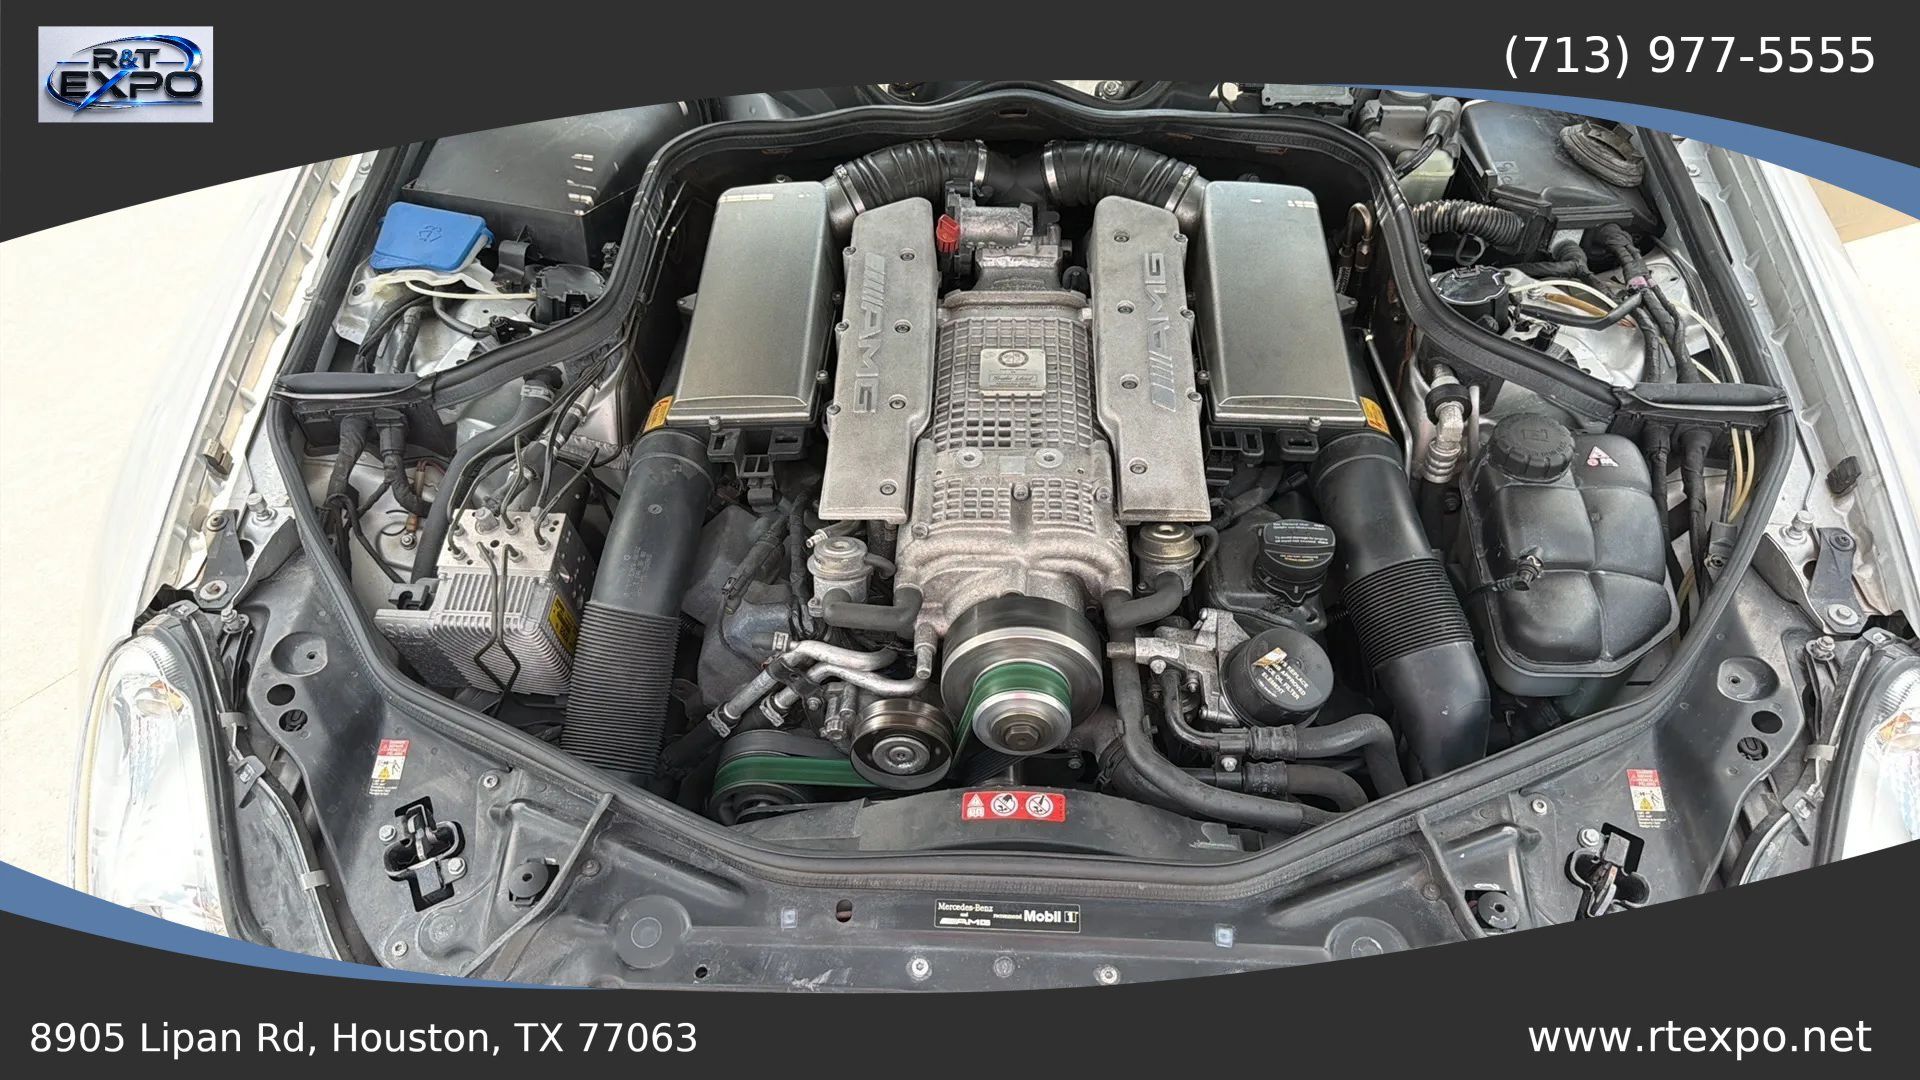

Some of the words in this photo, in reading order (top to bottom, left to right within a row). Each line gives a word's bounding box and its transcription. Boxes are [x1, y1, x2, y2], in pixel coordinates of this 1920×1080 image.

[1261, 671, 1285, 694] ELEMENT
[1275, 674, 1284, 684] OIL
[1283, 682, 1300, 700] FILTER
[1280, 670, 1306, 696] APPROVED
[1287, 665, 1309, 689] REPLACE
[937, 902, 994, 913] Mercedes-Benz
[1023, 909, 1062, 923] Mobil
